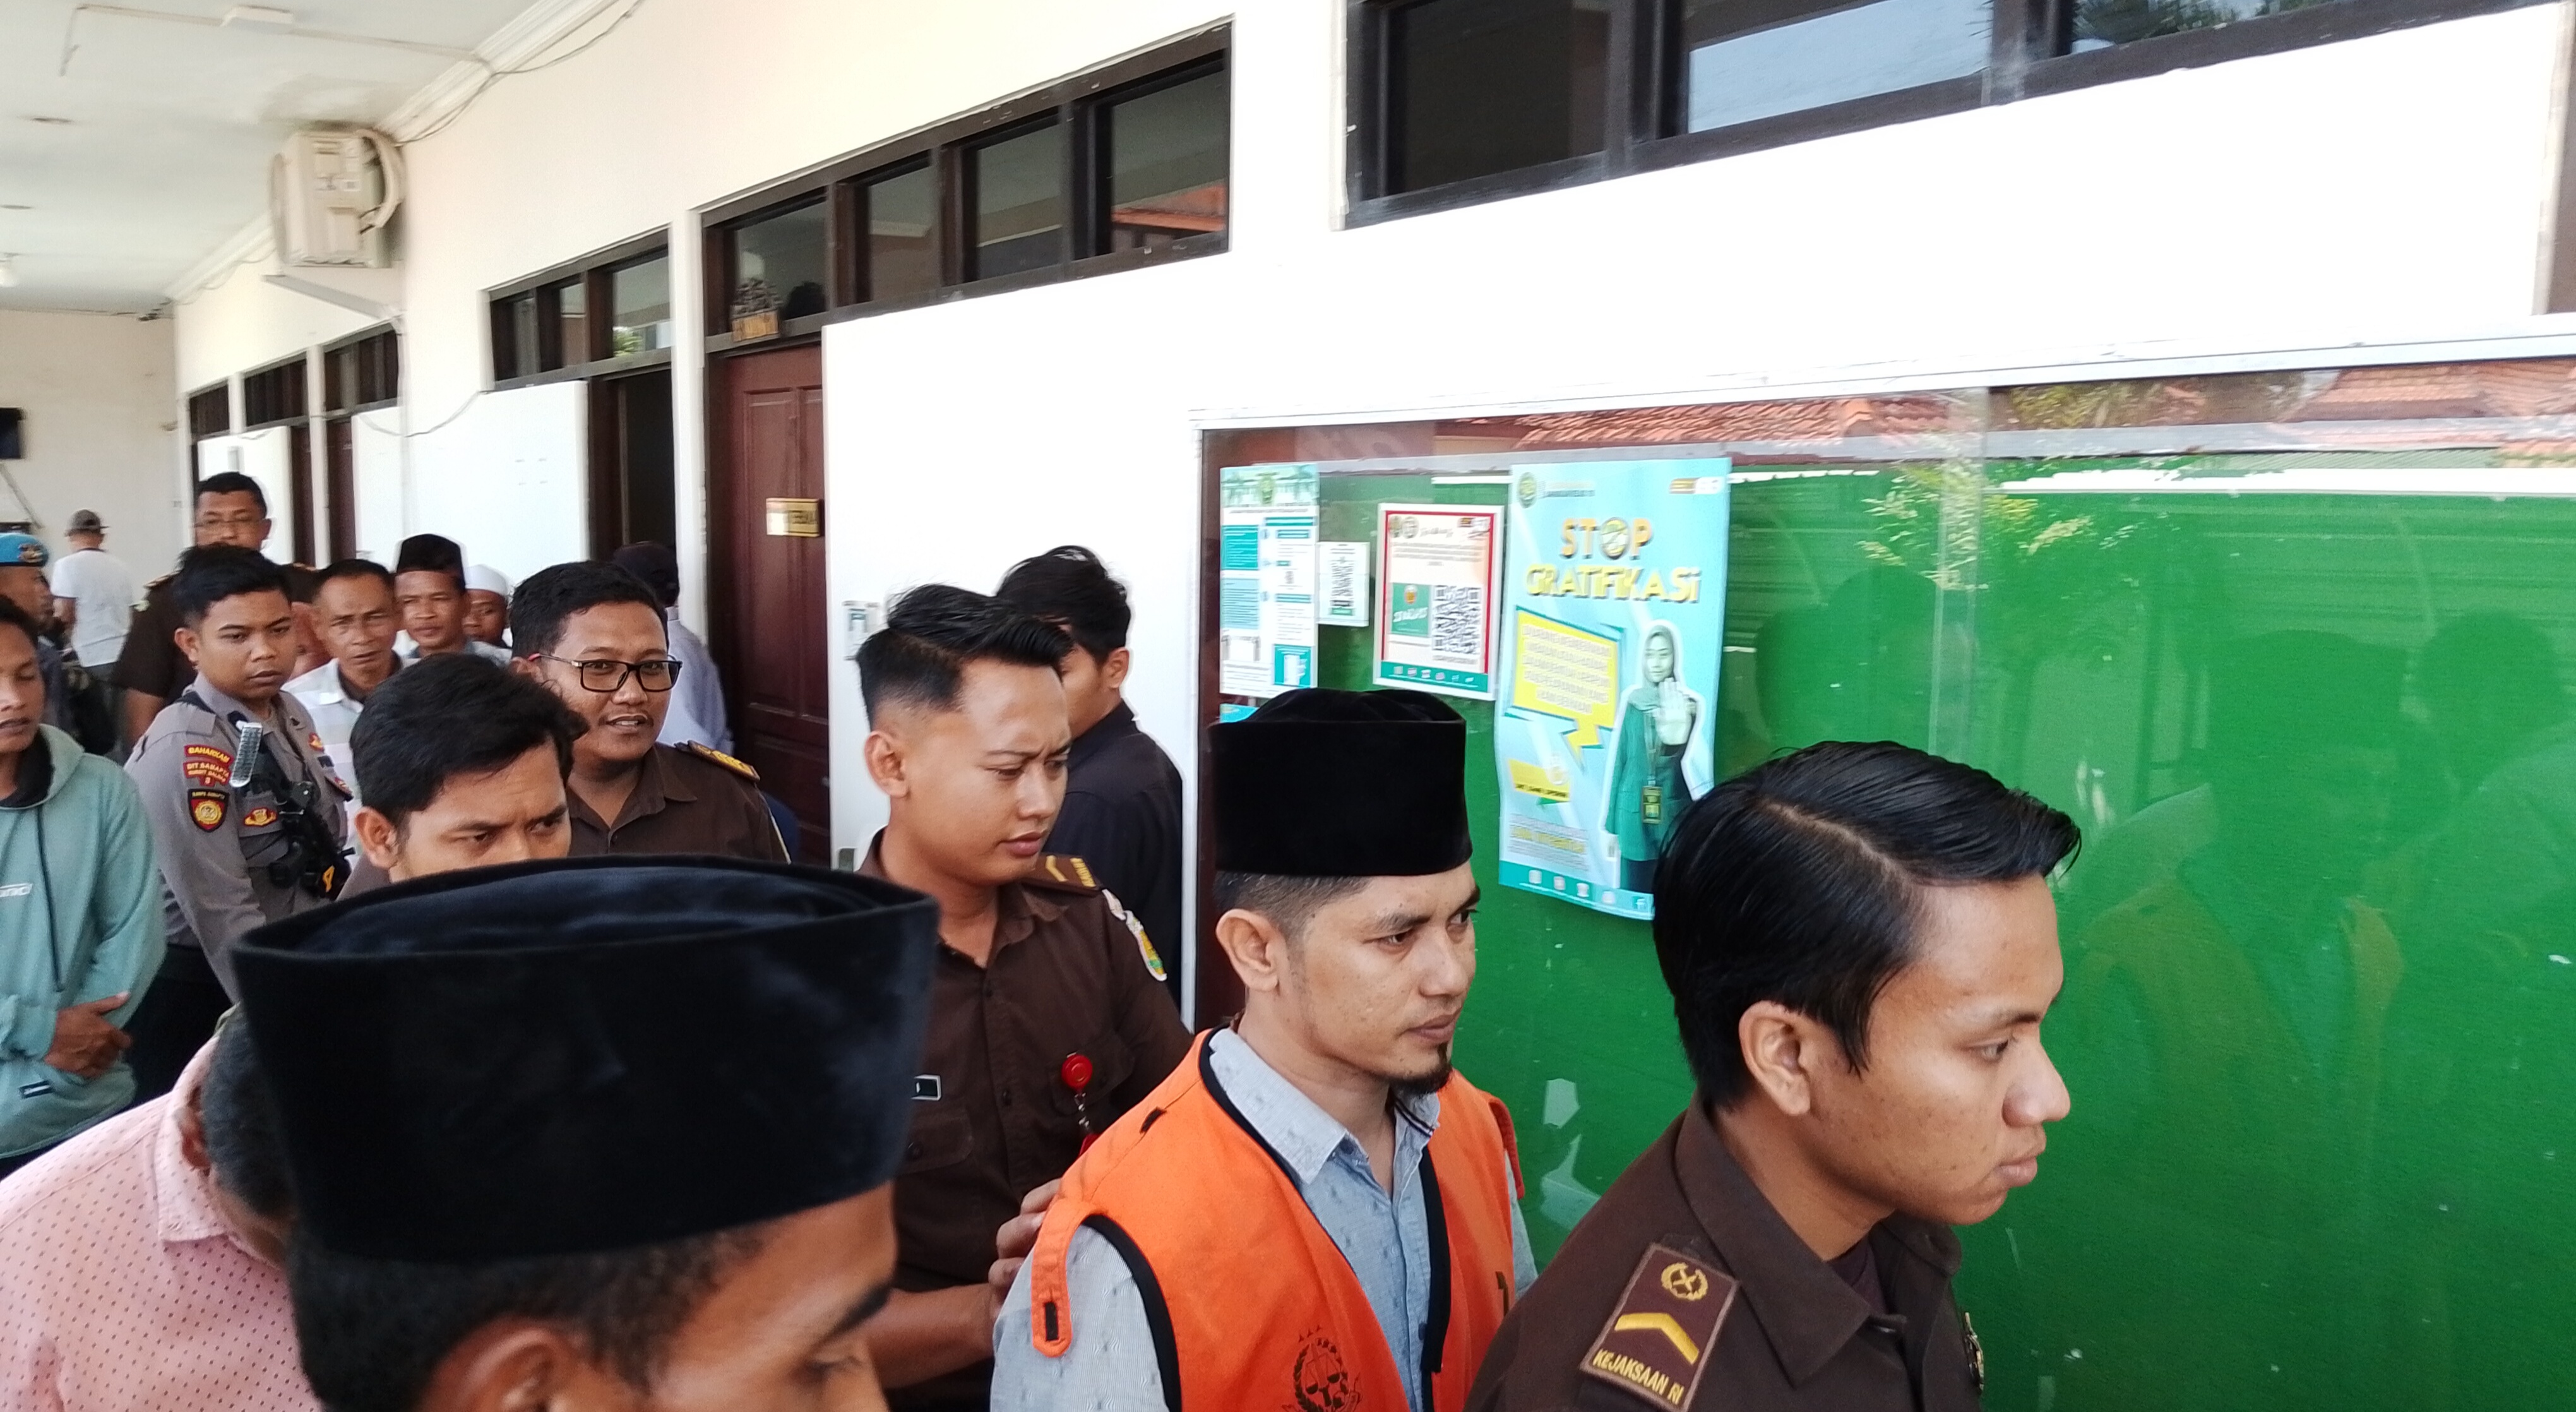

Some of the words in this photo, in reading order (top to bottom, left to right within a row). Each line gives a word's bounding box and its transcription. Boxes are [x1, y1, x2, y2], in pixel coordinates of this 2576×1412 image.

[1561, 517, 1653, 559] STOP
[1592, 1349, 1669, 1395] KEJAKSAAN
[1667, 1382, 1685, 1405] RI
